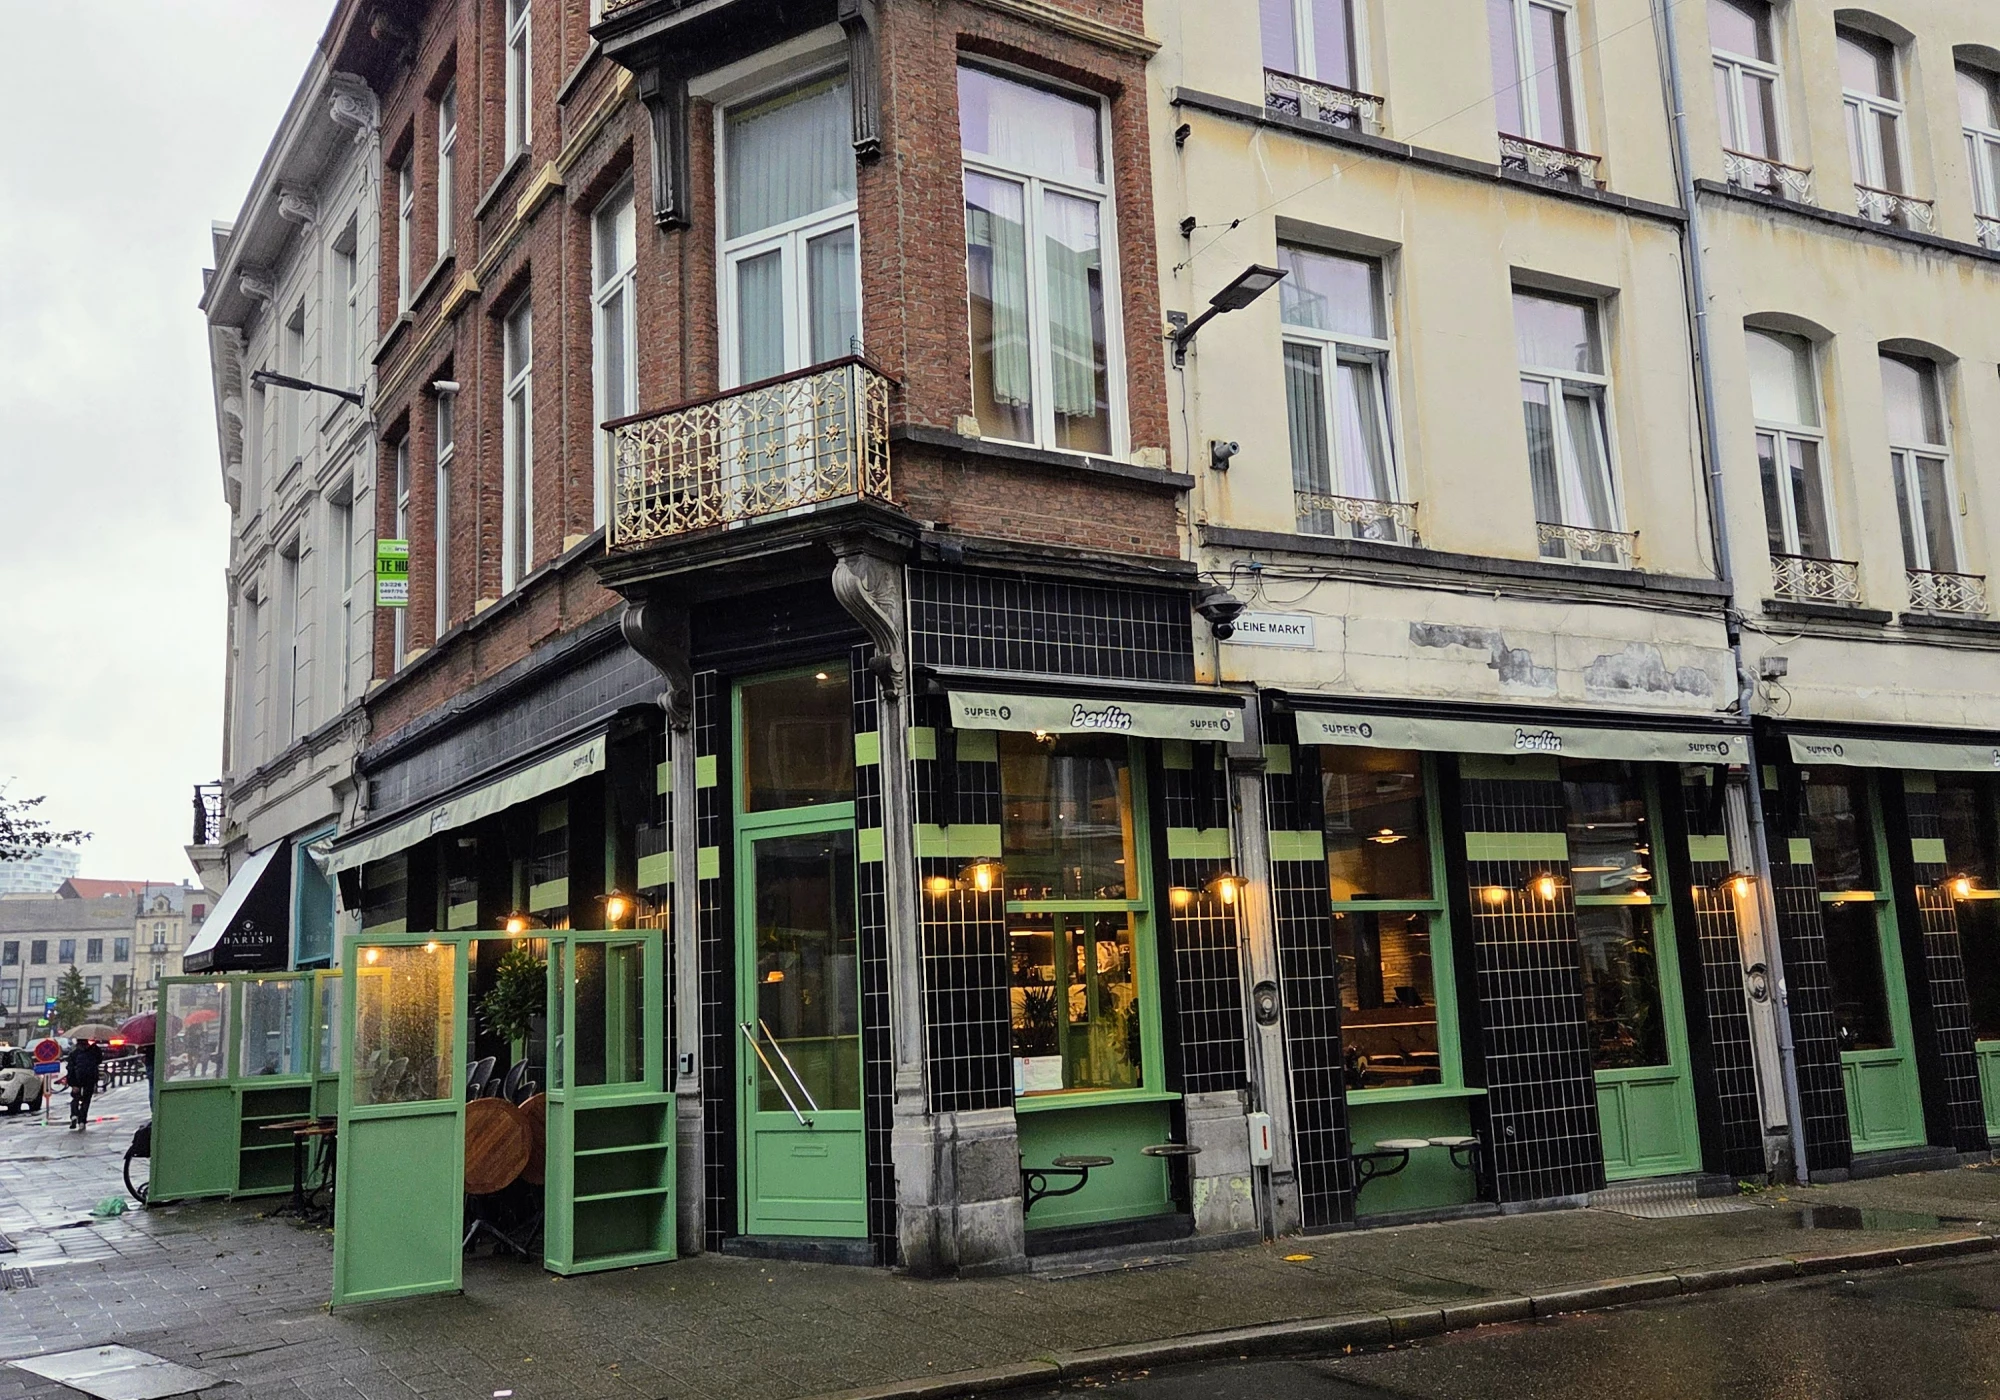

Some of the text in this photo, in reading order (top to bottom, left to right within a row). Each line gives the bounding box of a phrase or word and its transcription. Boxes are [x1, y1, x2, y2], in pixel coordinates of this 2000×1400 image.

[380, 560, 392, 572] TE
[1269, 624, 1306, 635] MARKT
[964, 707, 997, 717] SUPER
[1071, 703, 1132, 730] berlin
[1190, 719, 1219, 729] SUPER
[1322, 723, 1358, 735] SUPER
[1514, 728, 1562, 751] berlin
[1688, 742, 1717, 753] SUPER
[1806, 745, 1834, 755] SUPER
